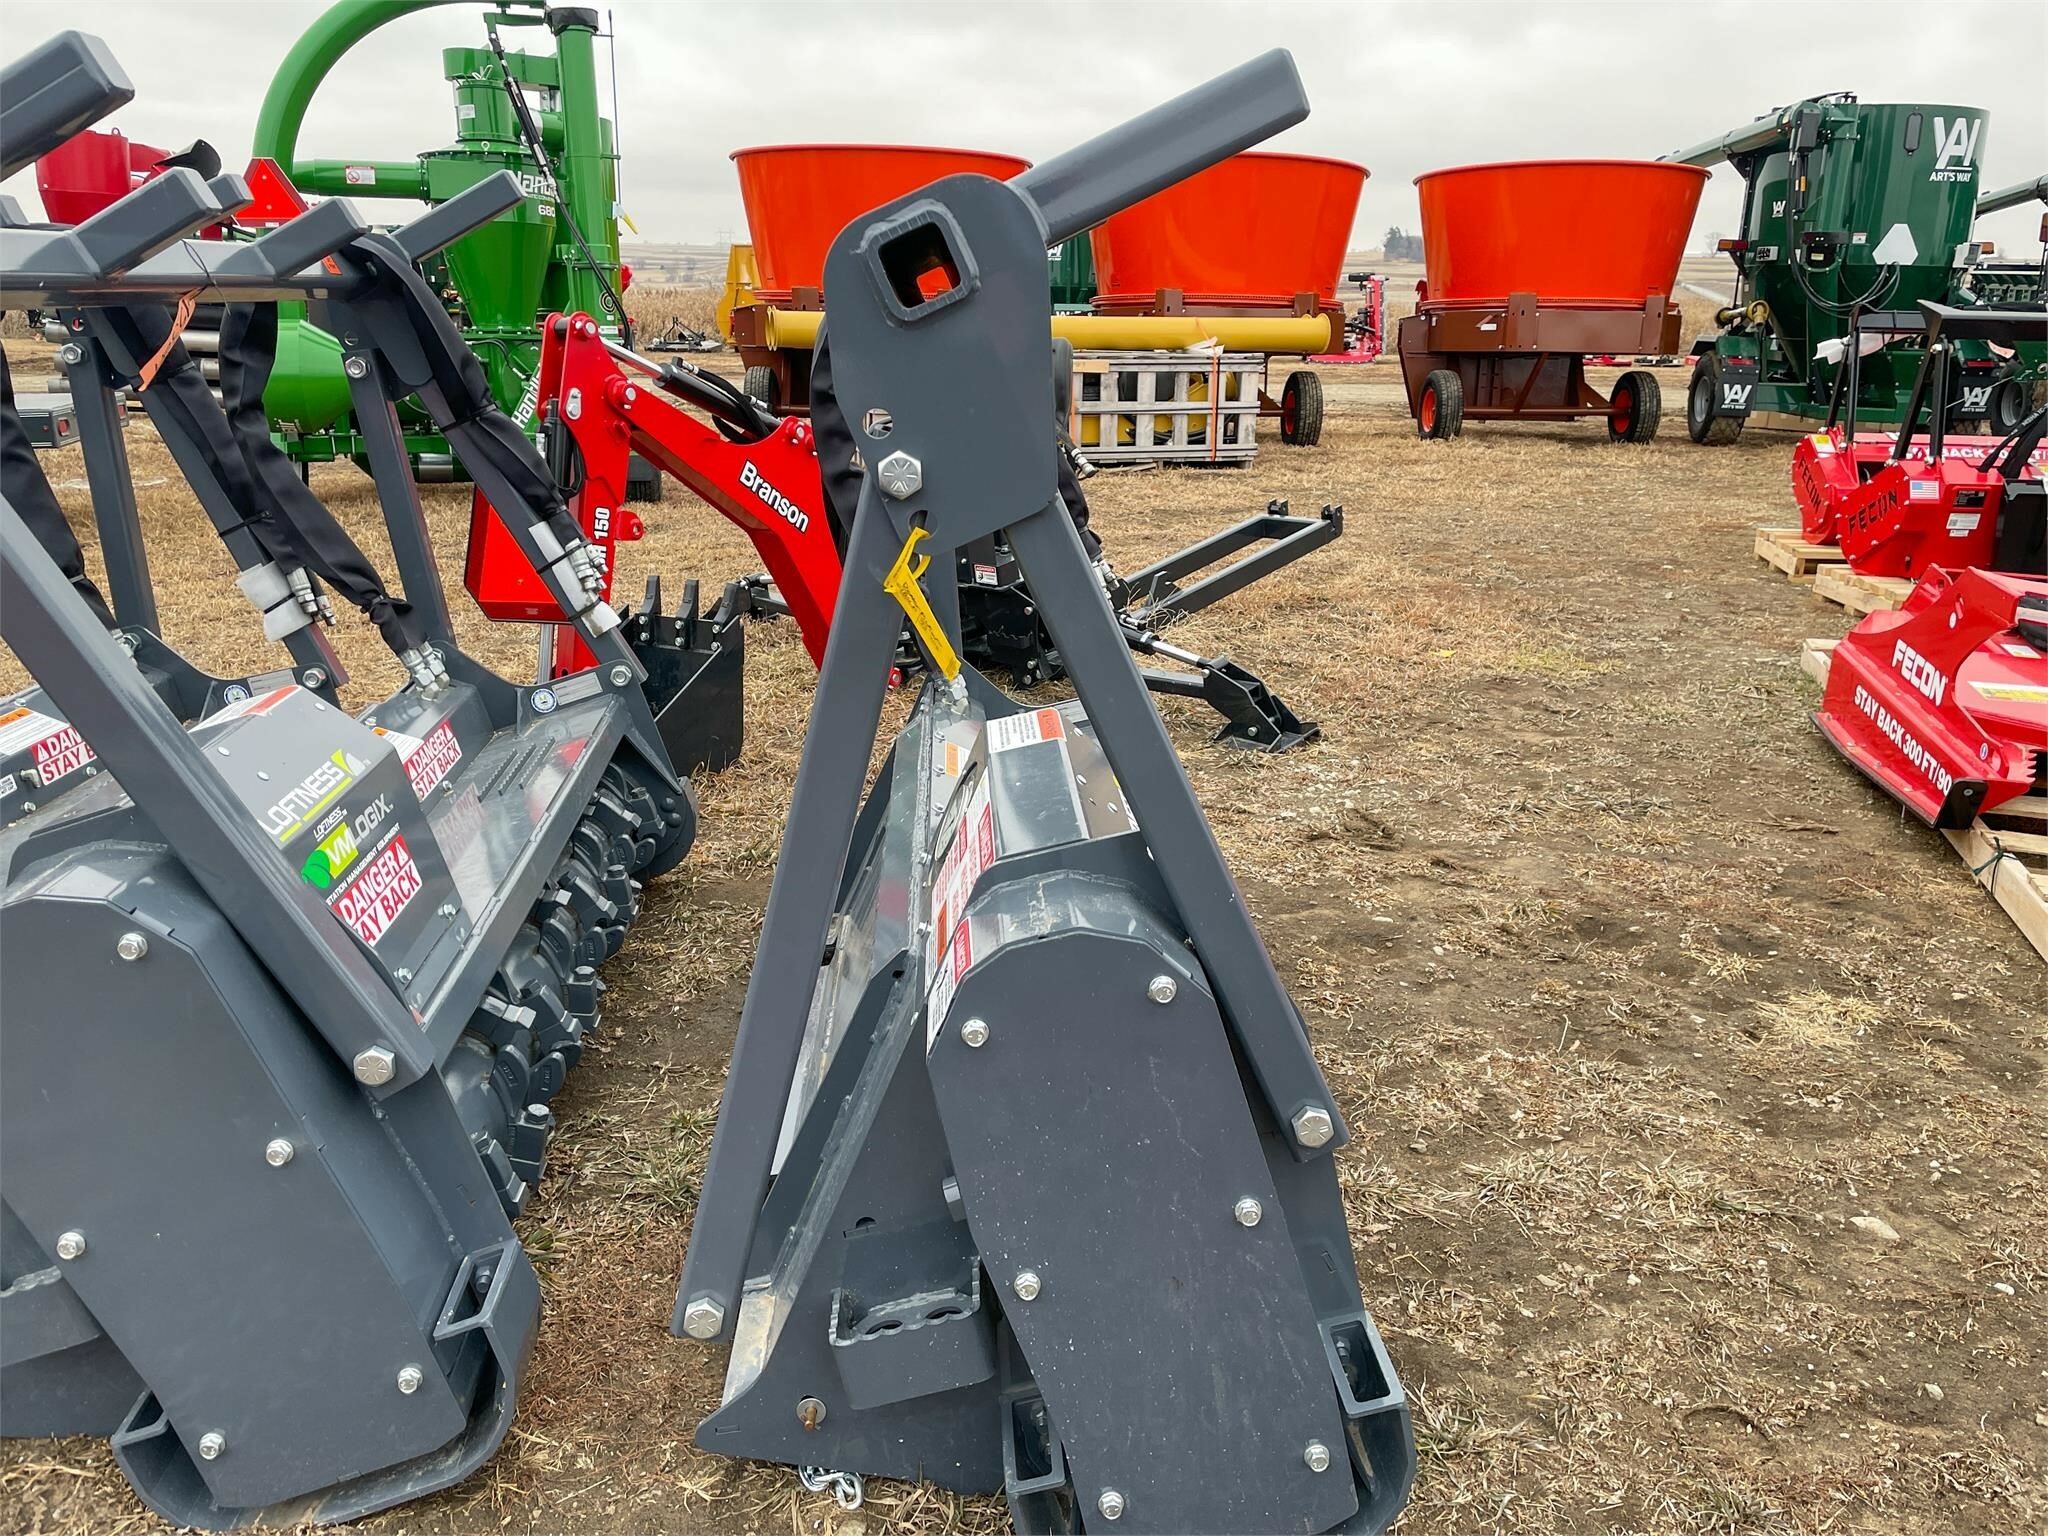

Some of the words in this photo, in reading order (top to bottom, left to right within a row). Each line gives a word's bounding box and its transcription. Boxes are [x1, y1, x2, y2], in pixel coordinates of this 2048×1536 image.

[1929, 171, 1955, 182] ART'S
[1956, 172, 1971, 182] WAY
[739, 460, 809, 533] Branson
[1798, 455, 1822, 515] FECON
[1848, 488, 1898, 537] FECON
[594, 507, 610, 539] 150
[1891, 638, 1947, 707] FECON
[46, 727, 82, 756] DAN
[412, 727, 448, 774] DANGER
[1854, 684, 1879, 721] STAY
[1876, 706, 1905, 750] BACK
[1902, 733, 1923, 767] 300
[42, 747, 82, 781] STAY
[415, 762, 439, 799] STAY
[436, 740, 461, 775] BACK
[256, 760, 345, 835] LOFTNESS
[313, 806, 342, 839] LOFTNESS
[325, 880, 348, 906] ETATION
[346, 846, 378, 885] MANAGEMENT
[338, 849, 401, 928] DANGER
[357, 905, 383, 943] AY
[379, 863, 420, 922] BACK
